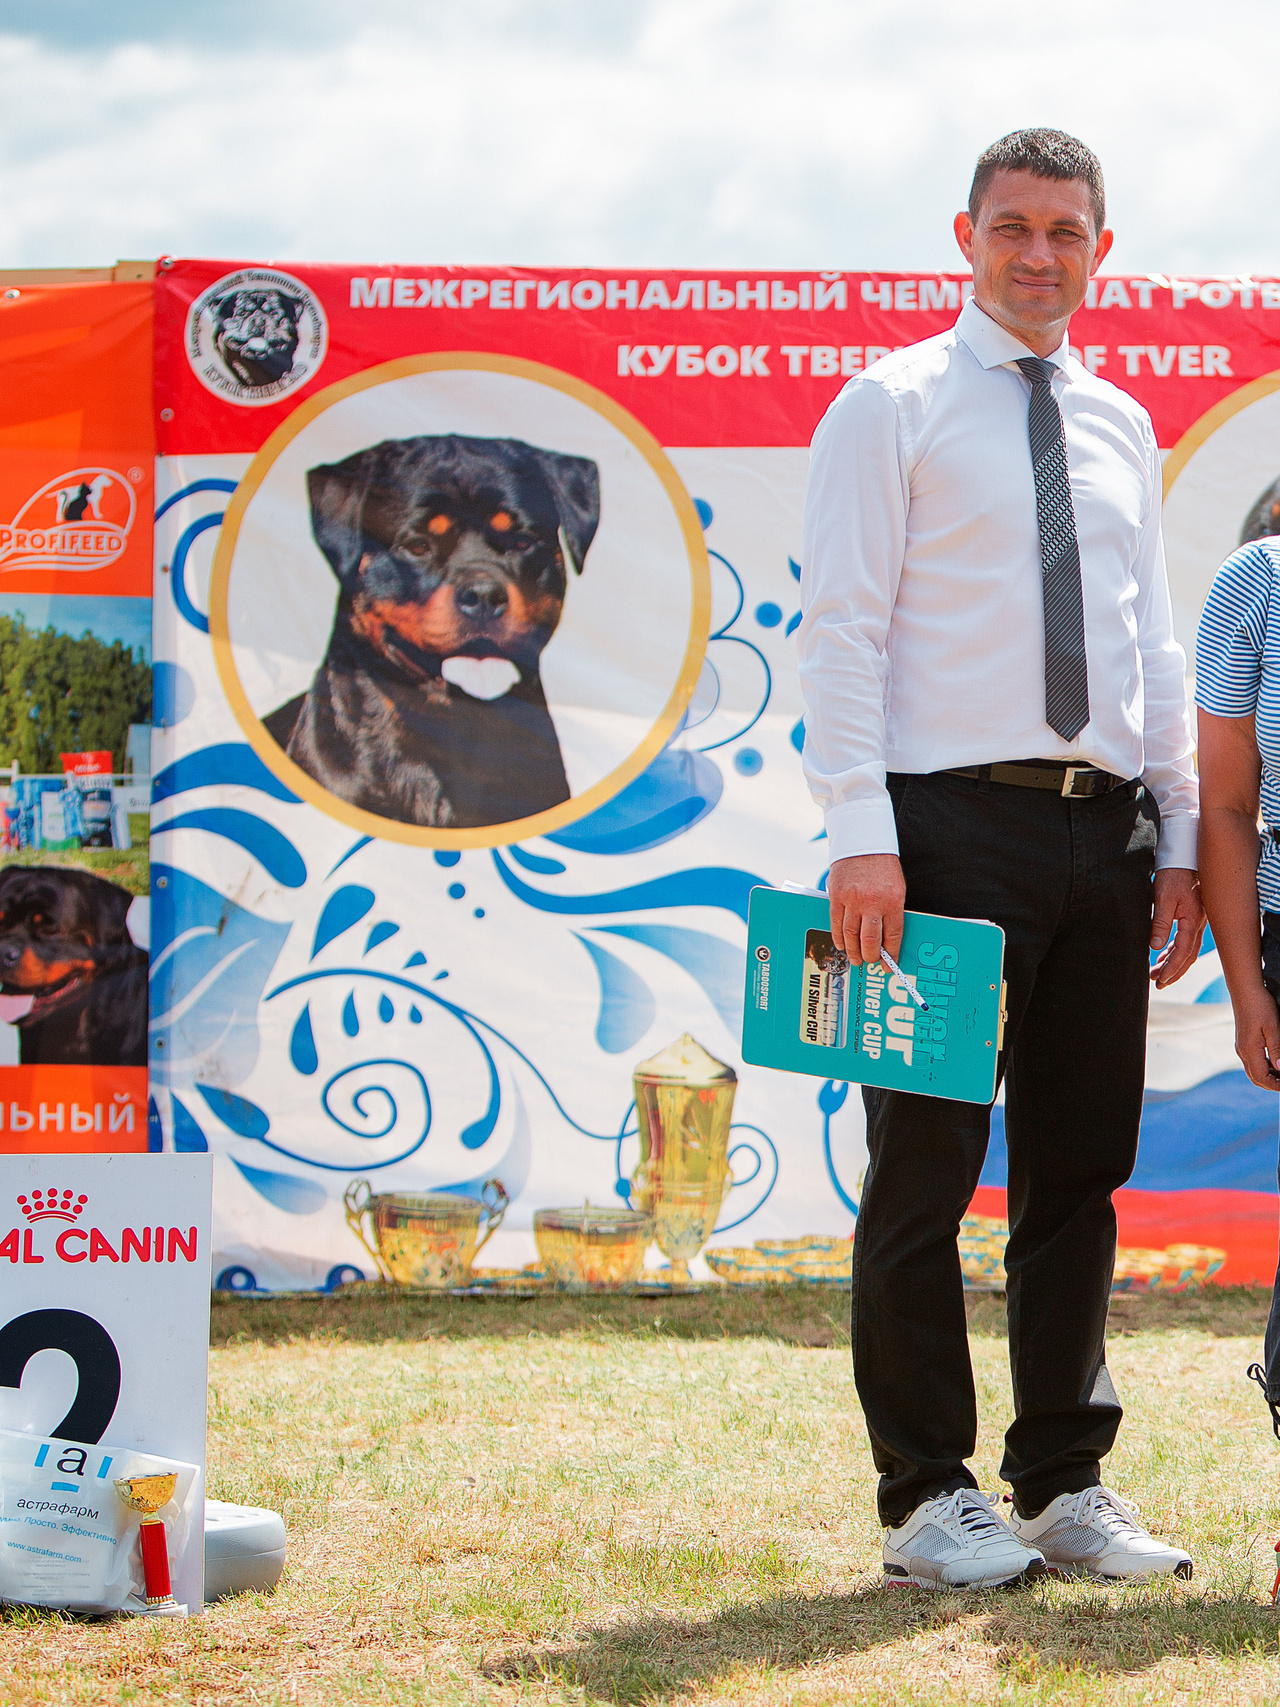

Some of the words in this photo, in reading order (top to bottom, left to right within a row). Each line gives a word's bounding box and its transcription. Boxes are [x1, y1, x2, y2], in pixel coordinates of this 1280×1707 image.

[349, 272, 847, 311] МЕЖРЕГИОНАЛЬНЫЙ
[617, 344, 770, 378] КУБОК
[1117, 345, 1235, 377] TVER
[759, 963, 770, 1011] TABOOSPORT
[809, 973, 821, 988] VII
[863, 962, 886, 1018] Silver
[807, 989, 820, 1020] Silver
[805, 1021, 818, 1042] CUP
[861, 1021, 883, 1060] CUP
[55, 1226, 198, 1263] CANIN
[16, 1498, 100, 1520] астрафарм
[24, 1516, 59, 1530] Просто.
[61, 1523, 118, 1547] Эффективно.
[7, 1541, 82, 1563] www.astrafarm.com
